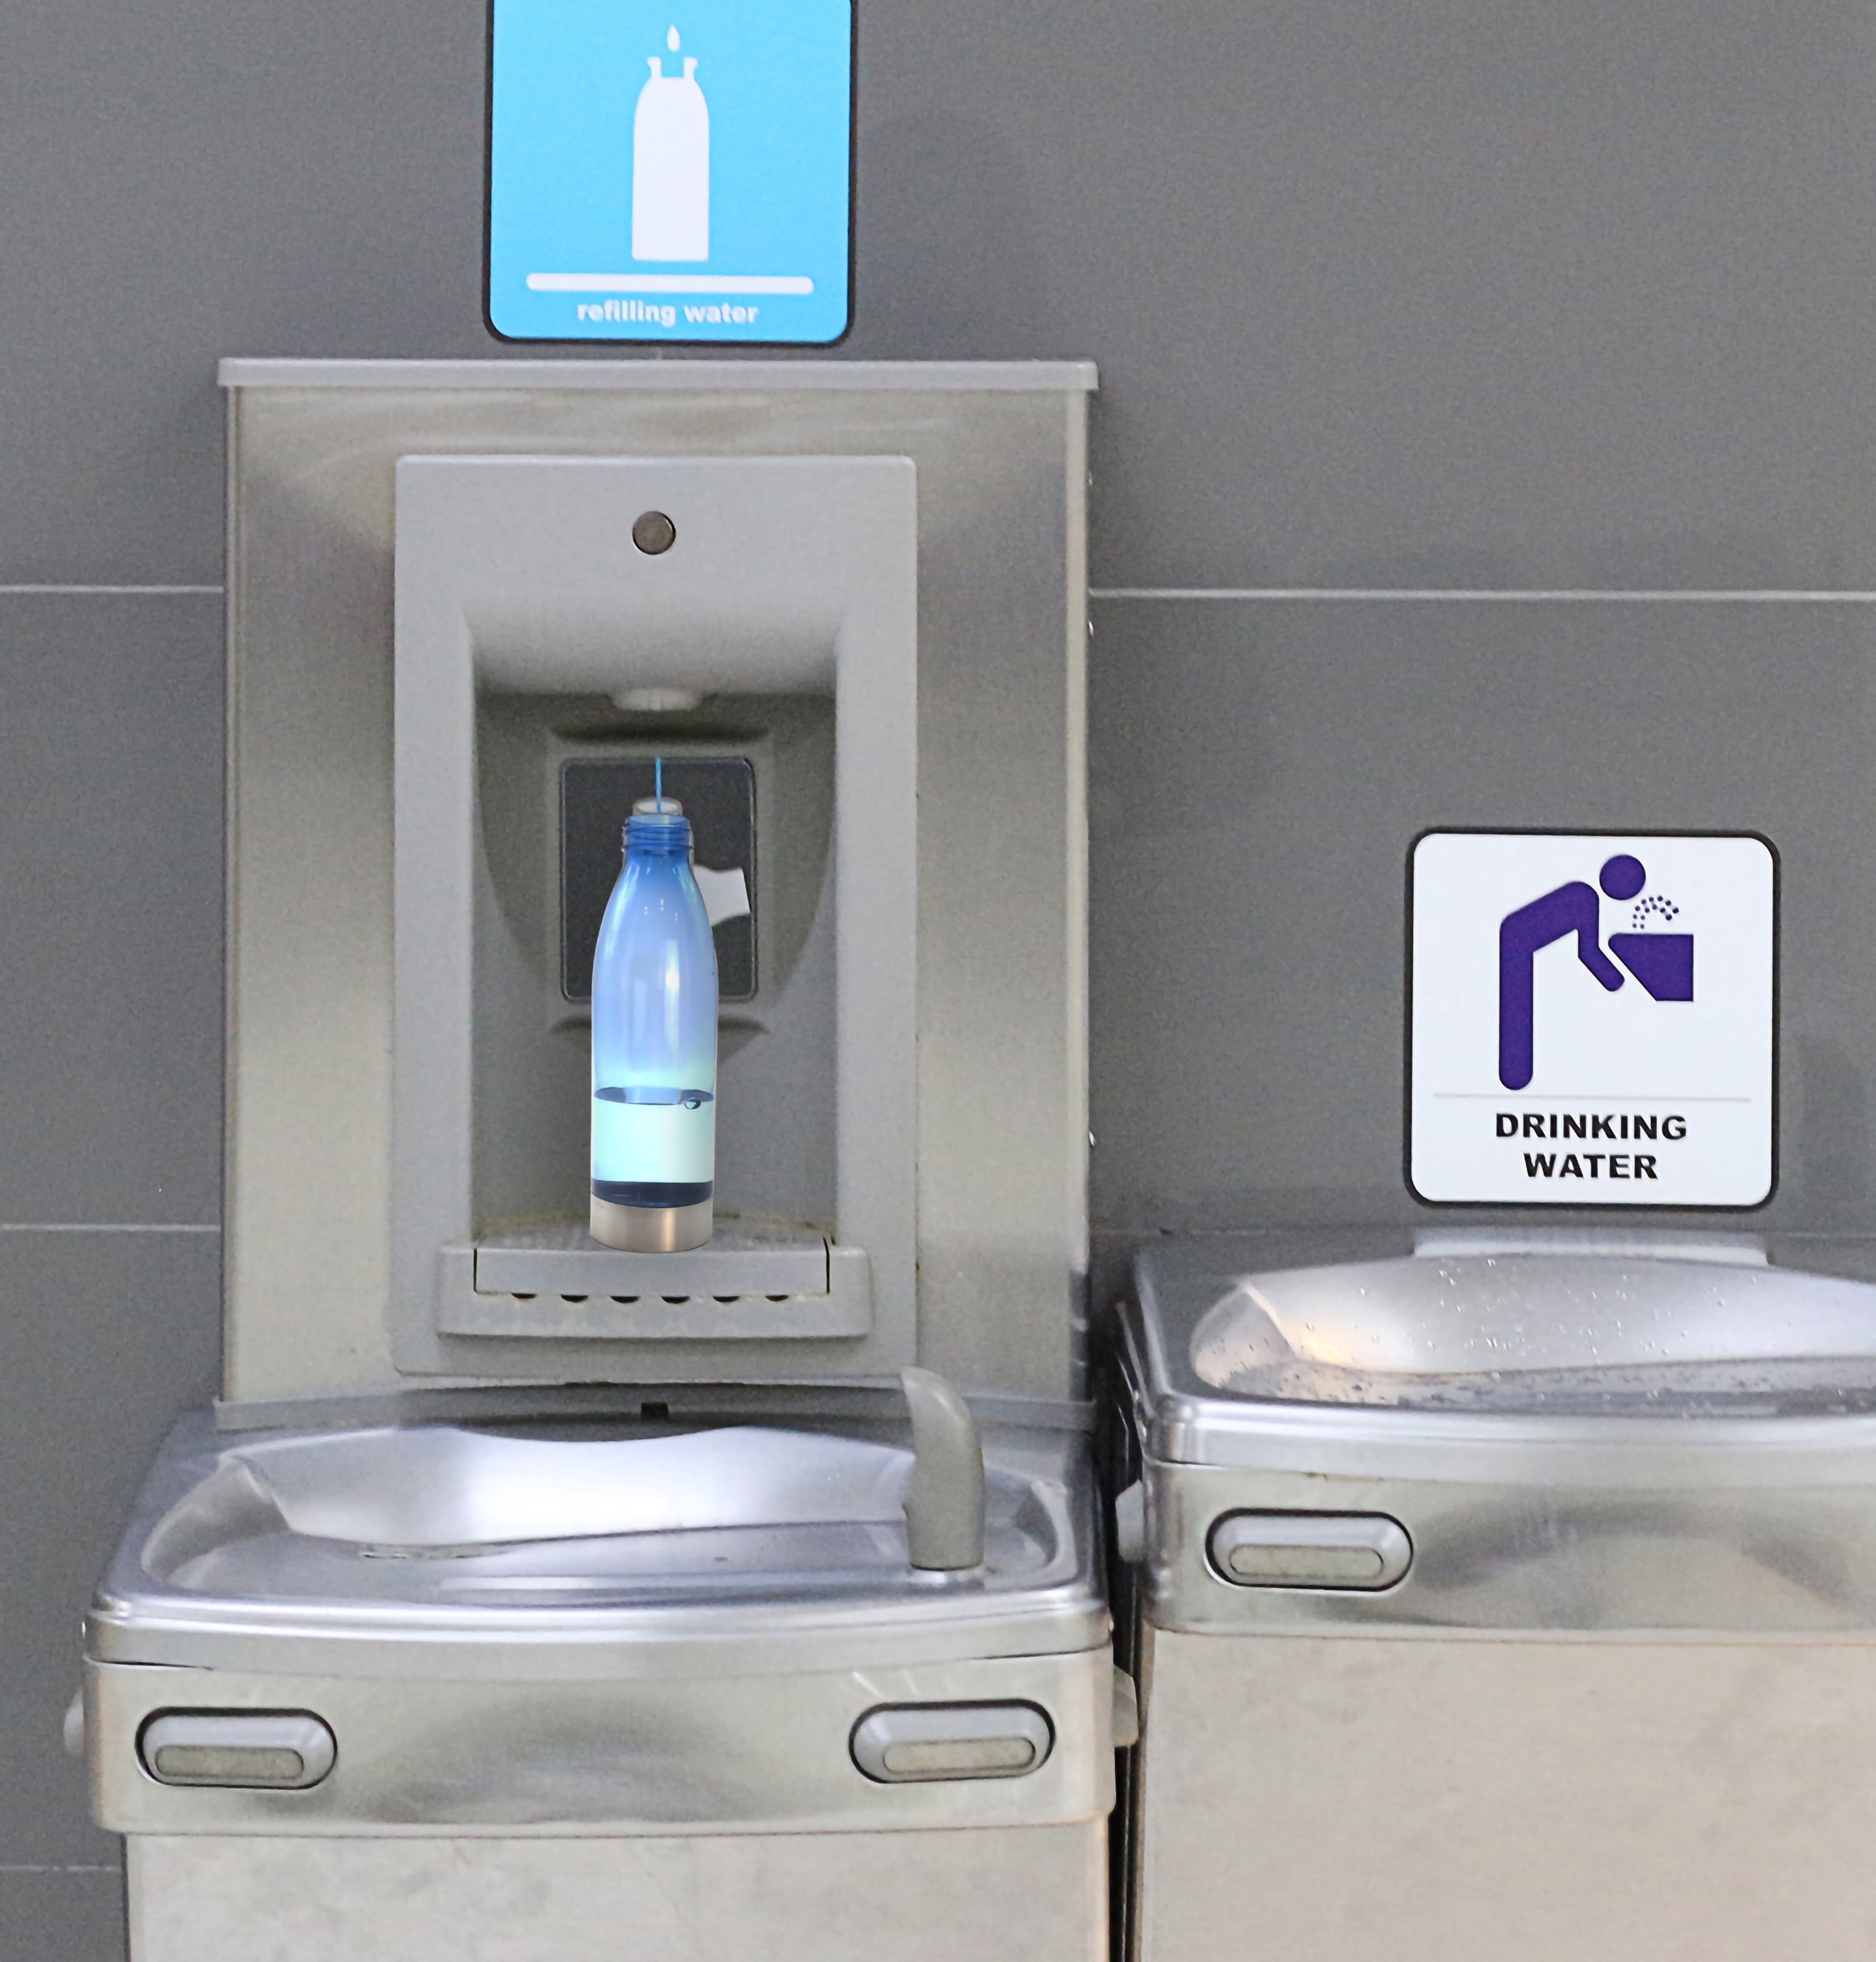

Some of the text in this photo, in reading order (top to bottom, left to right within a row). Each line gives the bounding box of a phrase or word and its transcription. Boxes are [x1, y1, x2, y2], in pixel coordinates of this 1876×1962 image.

[578, 300, 758, 327] refilling water
[1496, 1114, 1686, 1140] DRINKING
[1524, 1154, 1657, 1179] WATER
